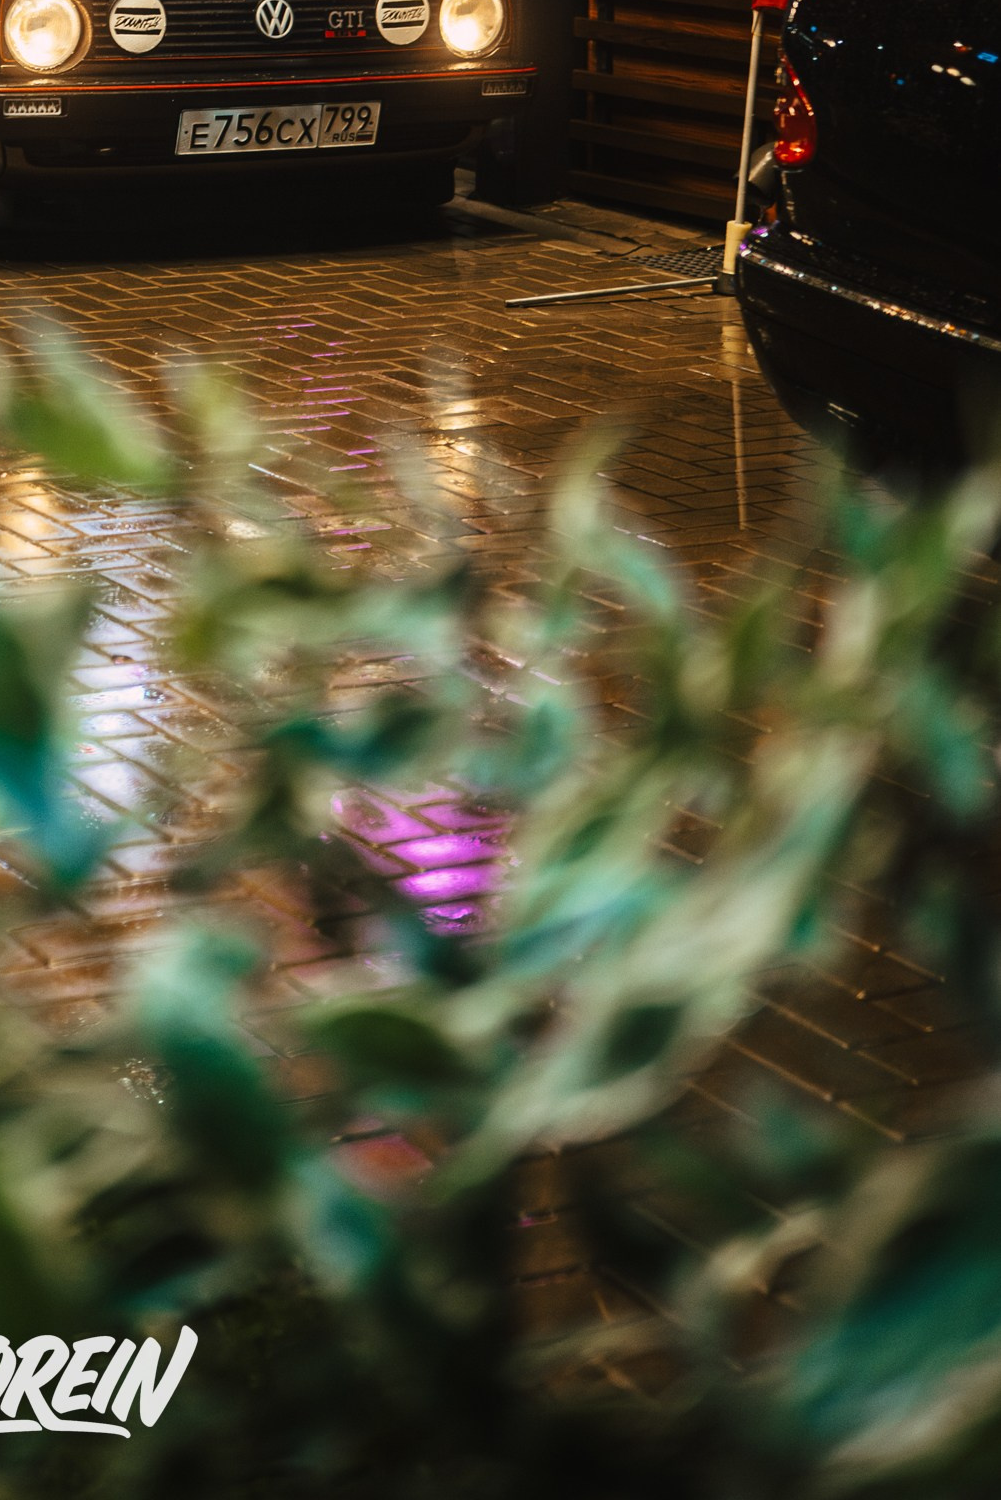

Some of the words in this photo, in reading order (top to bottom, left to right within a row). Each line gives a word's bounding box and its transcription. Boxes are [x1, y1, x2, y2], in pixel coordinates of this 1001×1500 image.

[328, 10, 365, 29] GTI
[325, 105, 372, 134] 799
[332, 131, 356, 143] RUS
